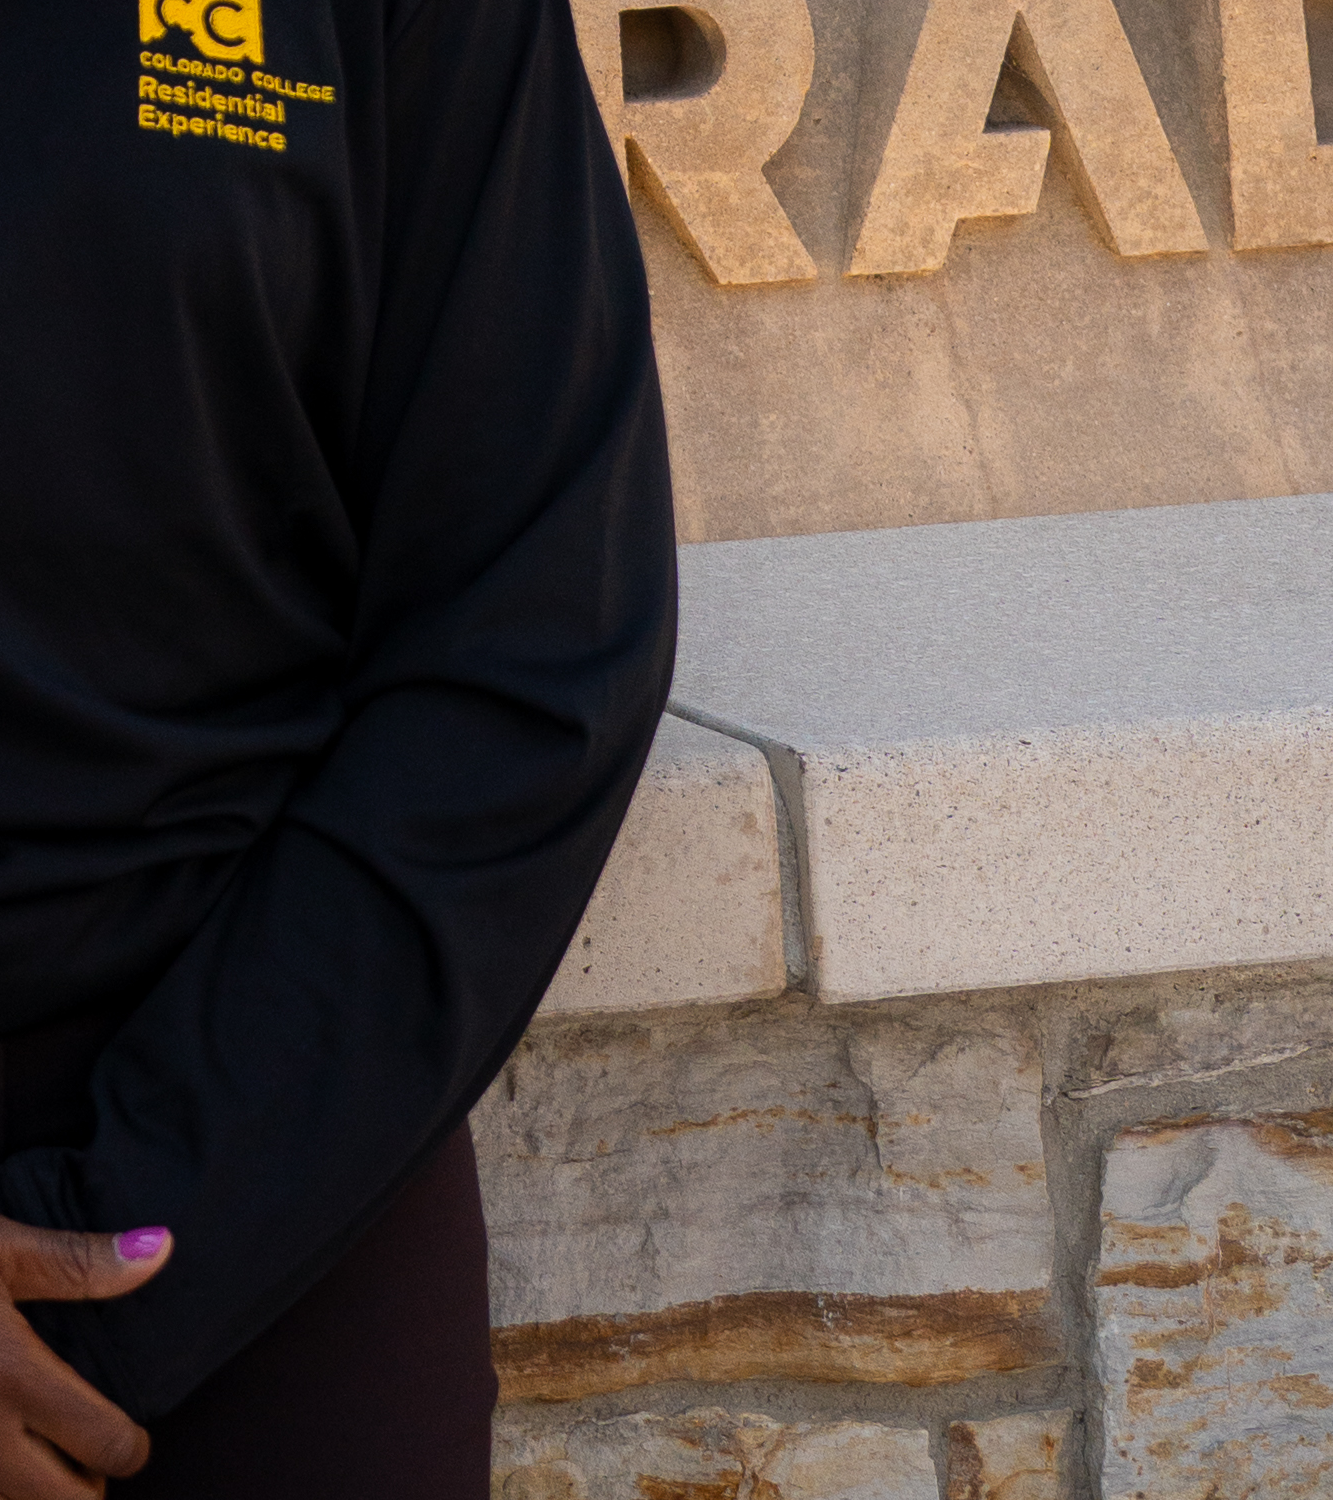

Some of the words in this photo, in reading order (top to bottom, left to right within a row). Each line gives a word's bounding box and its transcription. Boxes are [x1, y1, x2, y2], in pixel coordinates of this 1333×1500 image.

[139, 51, 245, 83] COLORADO
[251, 70, 336, 103] COLLEGE
[139, 75, 286, 124] Residential
[138, 104, 287, 151] Experience
